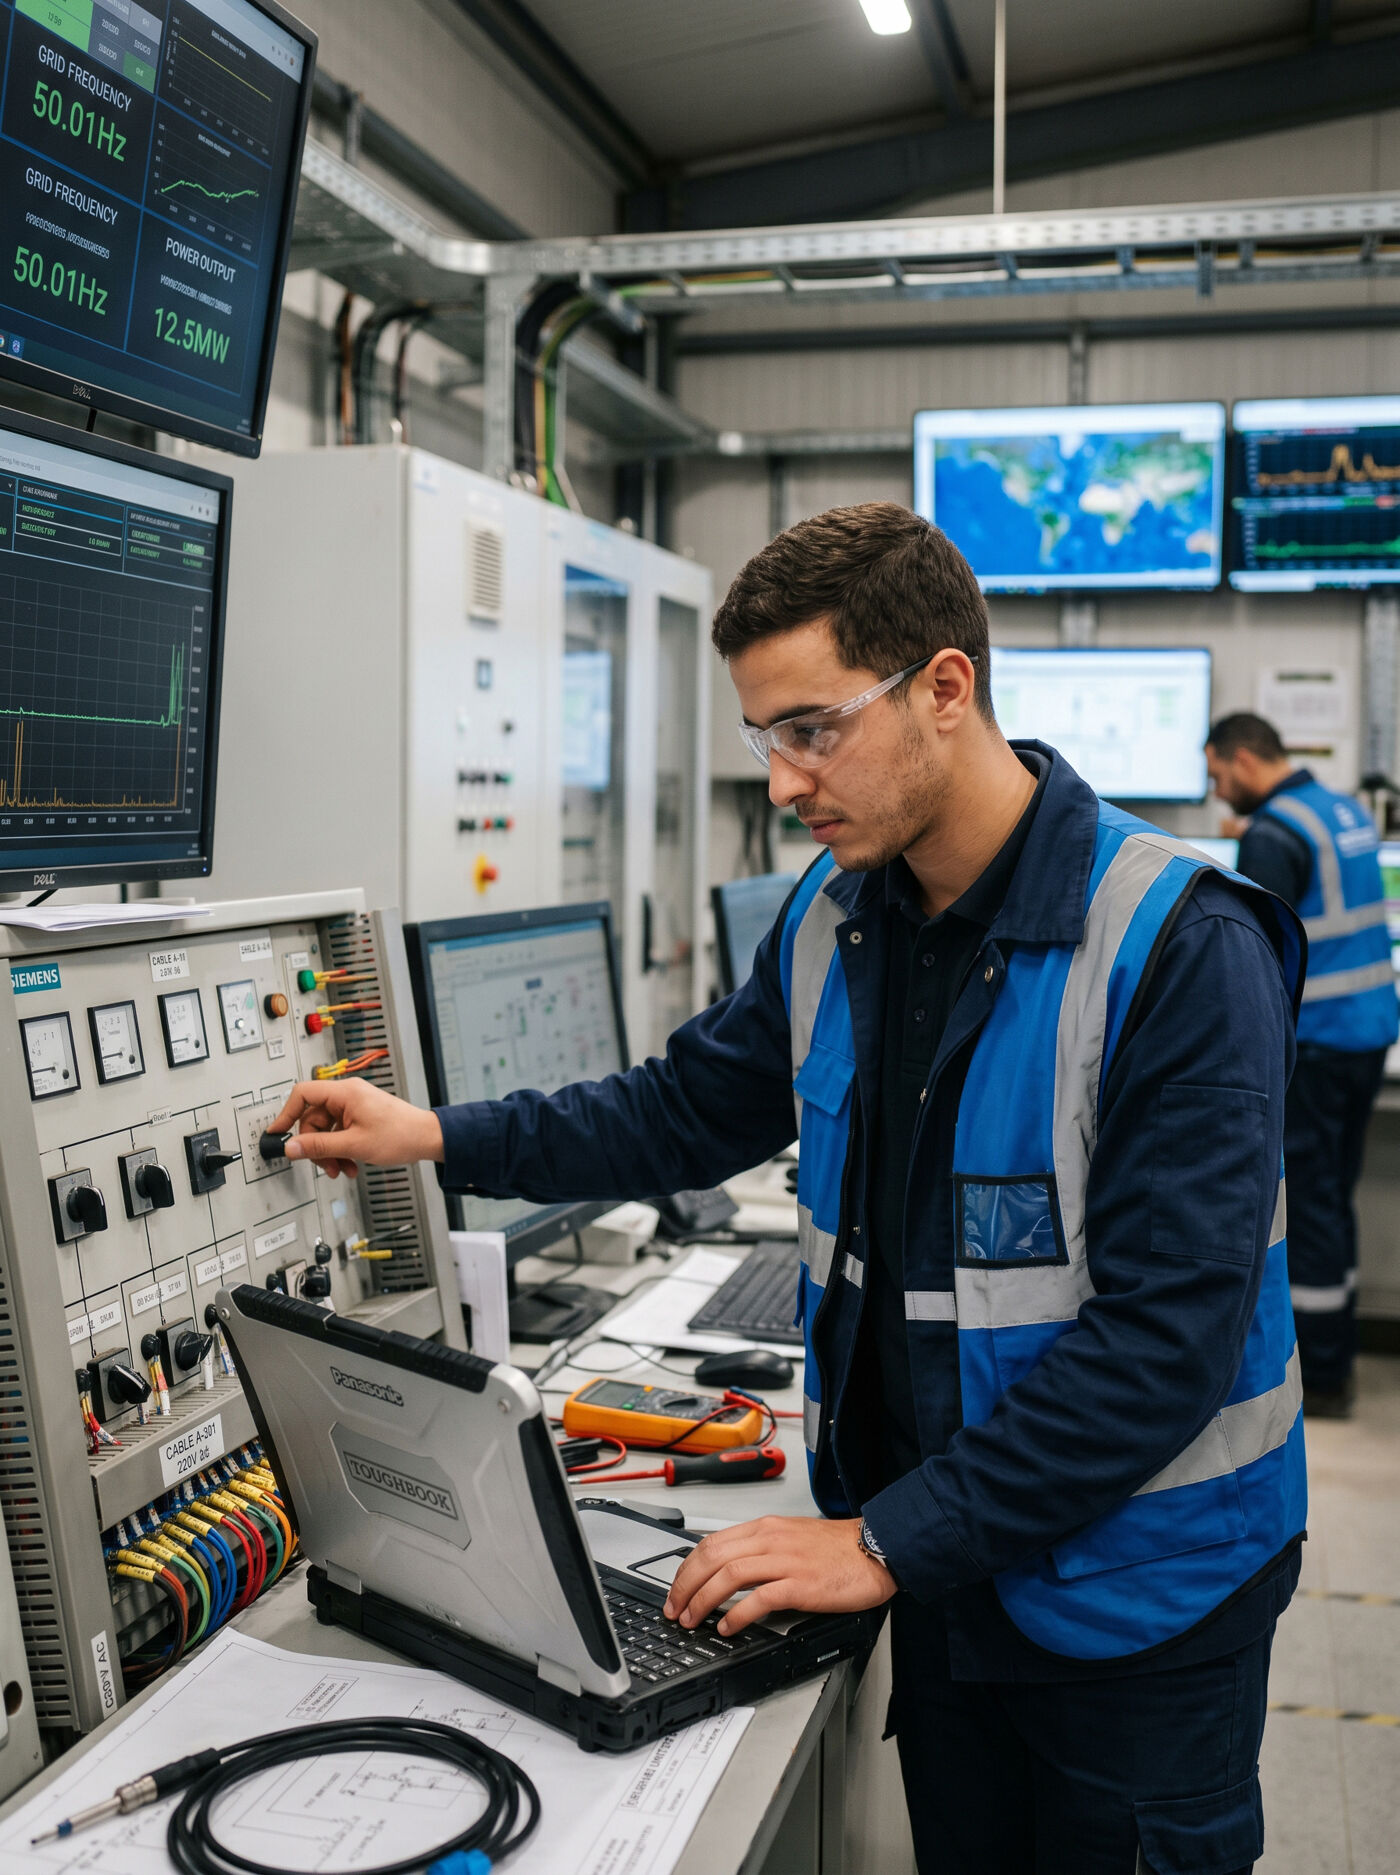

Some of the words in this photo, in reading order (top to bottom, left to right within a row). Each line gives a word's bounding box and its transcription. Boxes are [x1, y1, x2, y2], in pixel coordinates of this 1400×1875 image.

[38, 44, 65, 73] GRID
[68, 62, 132, 112] FREQUENCY
[32, 80, 127, 162] 50.01Hz
[25, 167, 53, 194] GRID
[55, 181, 118, 225] FREQUENCY
[13, 245, 108, 315] 50.01Hz
[165, 237, 200, 267] POWER
[200, 254, 236, 283] OUTPUT
[154, 307, 230, 364] 12.5MW
[11, 969, 58, 988] SIEMENS
[152, 954, 172, 966] CABLE
[330, 1366, 404, 1407] Panasonic
[166, 1435, 194, 1460] CABLE
[177, 1452, 197, 1474] 220V
[350, 1460, 451, 1511] TOUGHBOOK
[97, 1642, 107, 1662] AC
